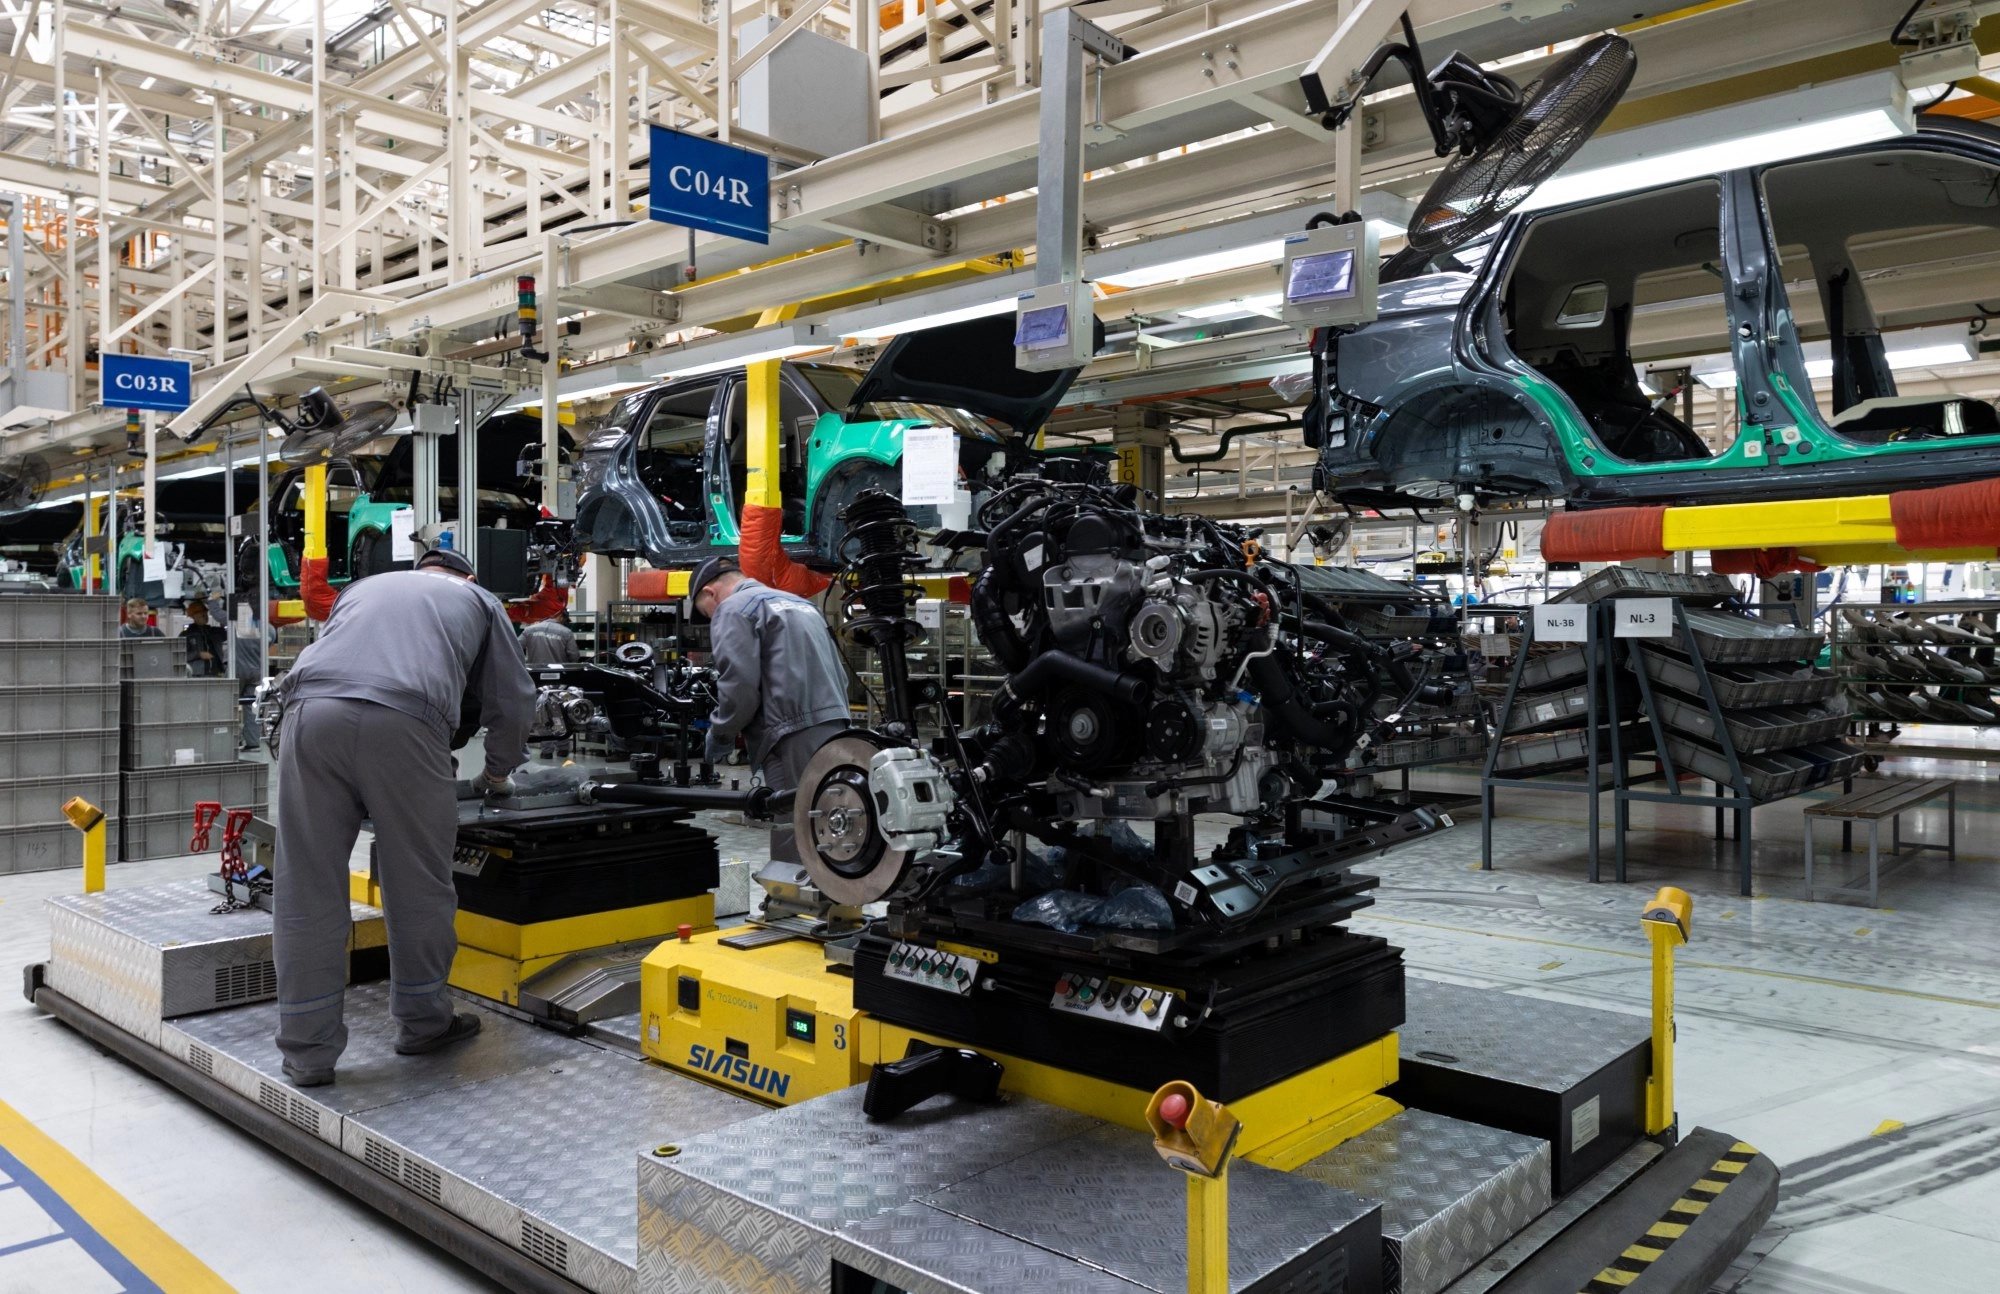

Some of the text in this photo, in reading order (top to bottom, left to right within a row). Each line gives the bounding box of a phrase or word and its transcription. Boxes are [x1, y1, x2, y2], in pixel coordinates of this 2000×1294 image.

[669, 165, 753, 208] C04R
[115, 373, 178, 394] C03R
[1547, 619, 1575, 628] NL-3B
[1630, 613, 1655, 624] NL-3
[833, 1023, 847, 1050] 3
[687, 1043, 791, 1098] SIASUN
